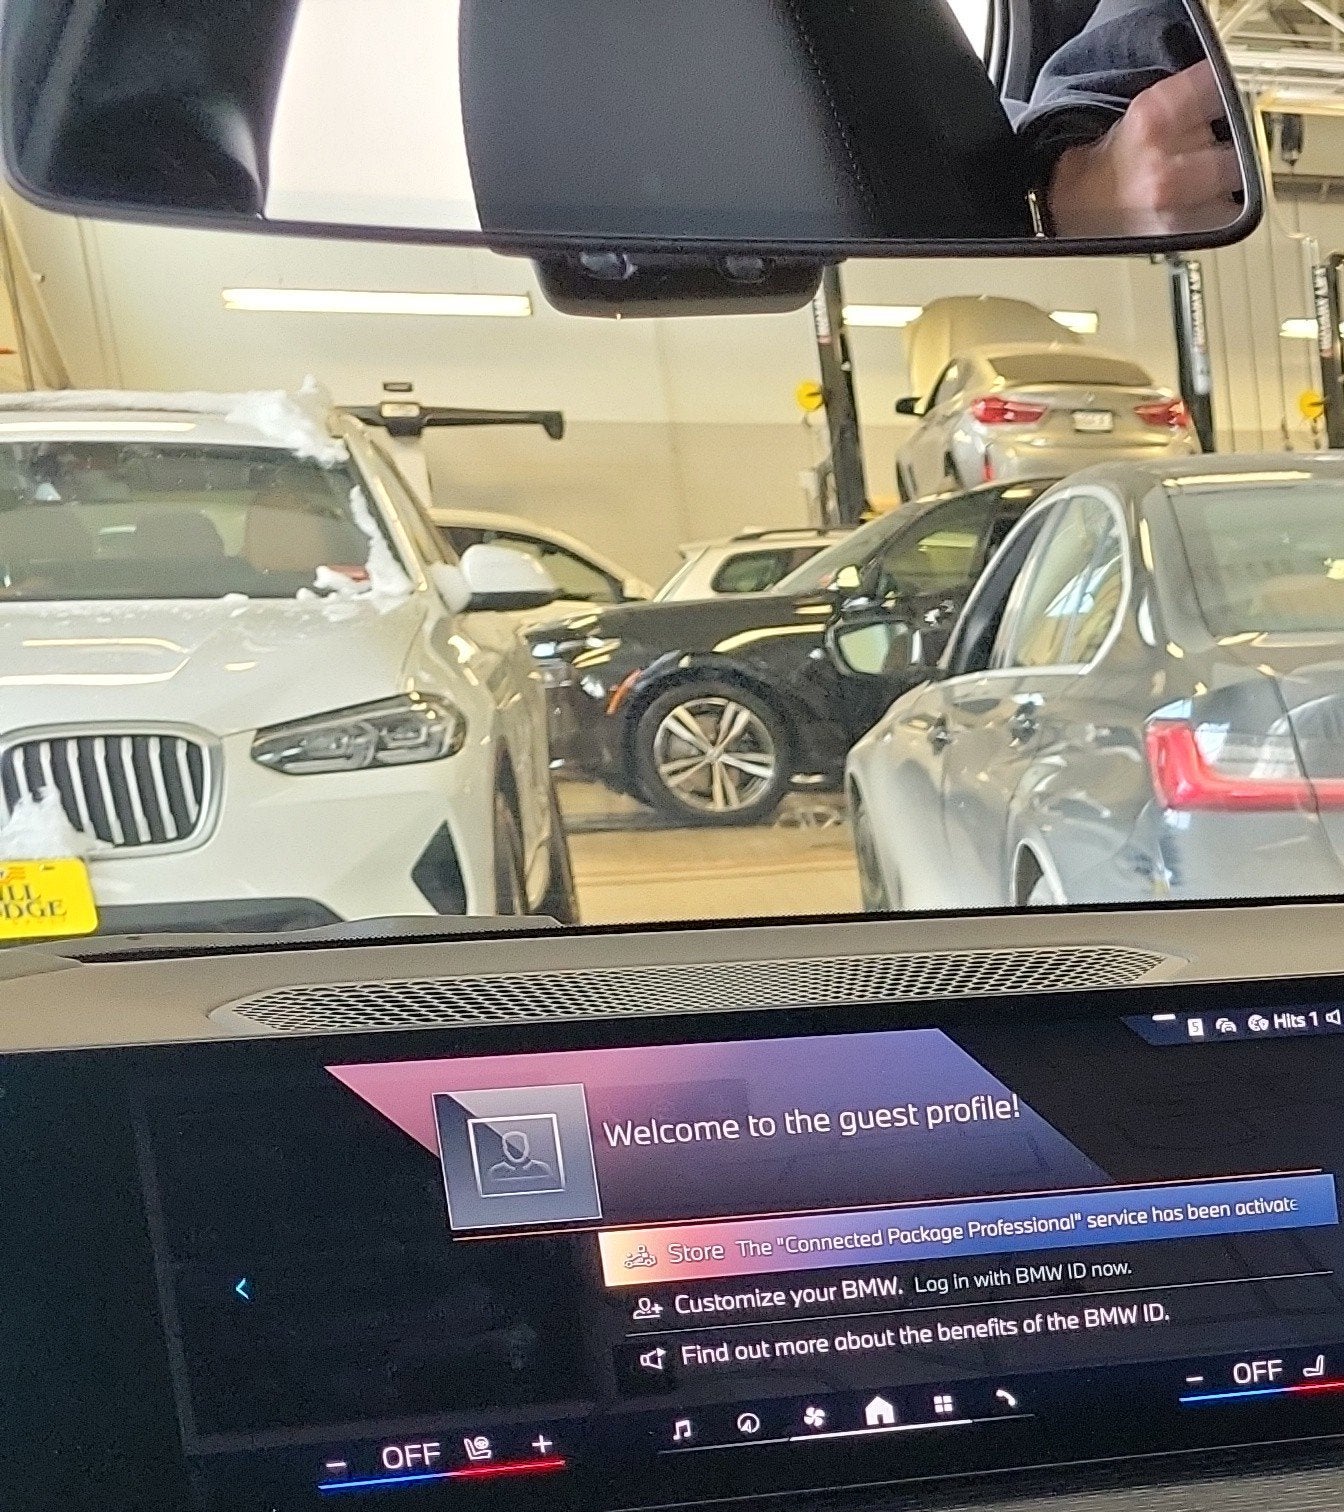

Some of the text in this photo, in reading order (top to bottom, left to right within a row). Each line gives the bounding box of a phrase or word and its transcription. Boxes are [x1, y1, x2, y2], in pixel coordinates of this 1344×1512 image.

[1274, 1012, 1307, 1030] Hits
[1309, 1011, 1320, 1027] 1
[602, 1093, 1021, 1147] Welcome to the guest profile!
[668, 1241, 726, 1265] Store
[735, 1239, 773, 1259] The
[777, 1228, 884, 1254] "Connected
[888, 1224, 964, 1247] Package
[968, 1211, 1082, 1239] Professional"
[1087, 1207, 1149, 1230] service
[1152, 1205, 1185, 1224] has
[1187, 1201, 1232, 1221] been
[674, 1260, 1134, 1315] Customize your BMW. Log in with BMW ID now.
[681, 1302, 1171, 1366] Find out more about the benefits of the BMW ID.
[1232, 1358, 1284, 1384] OFF
[381, 1441, 442, 1470] OFF
